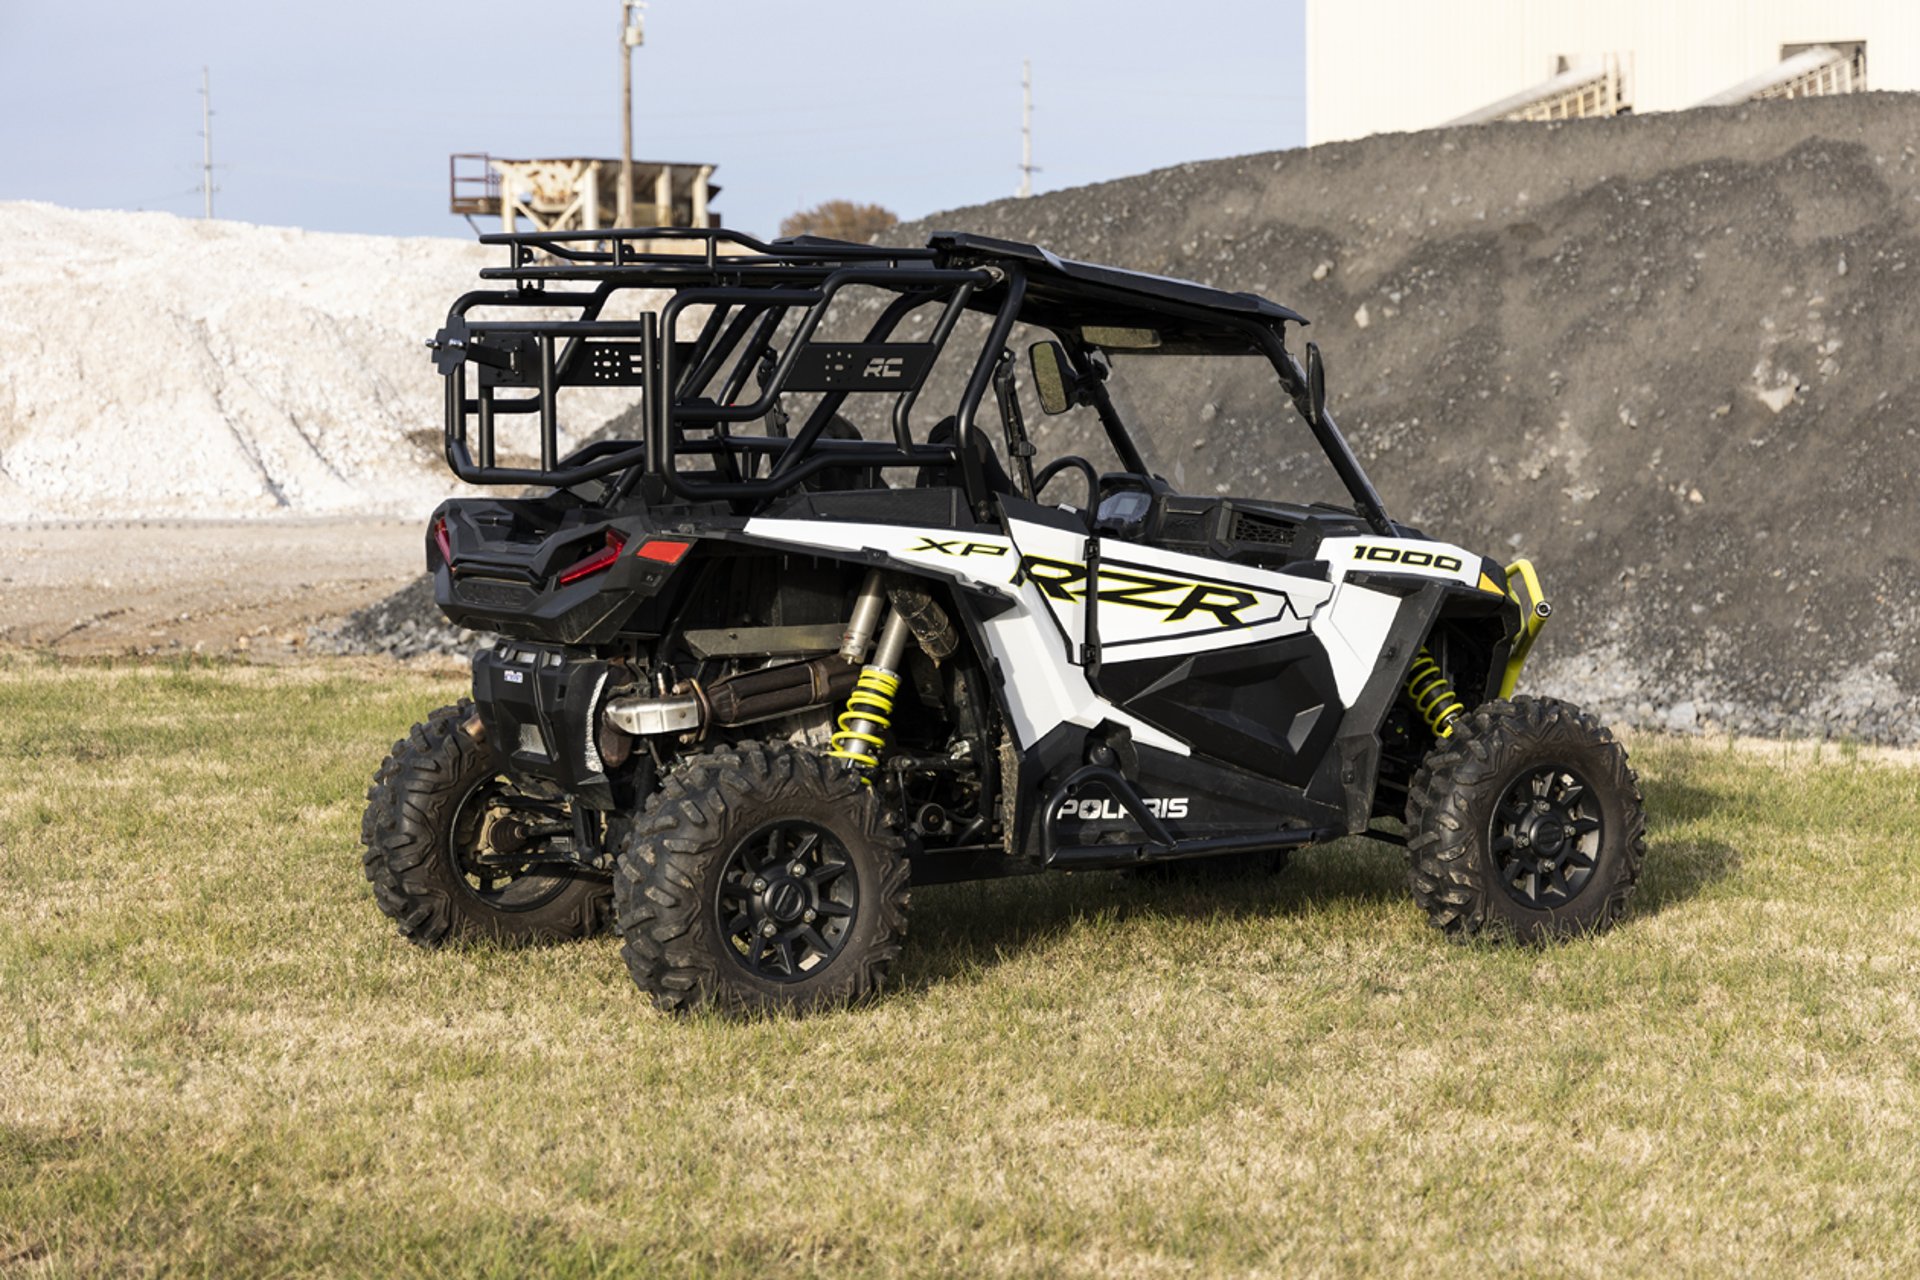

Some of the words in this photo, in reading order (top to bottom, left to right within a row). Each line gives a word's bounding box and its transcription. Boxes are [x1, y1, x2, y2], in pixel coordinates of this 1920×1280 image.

[863, 358, 903, 377] RC
[905, 536, 1009, 556] XP
[1353, 545, 1462, 572] 1000
[1010, 554, 1259, 630] RZR
